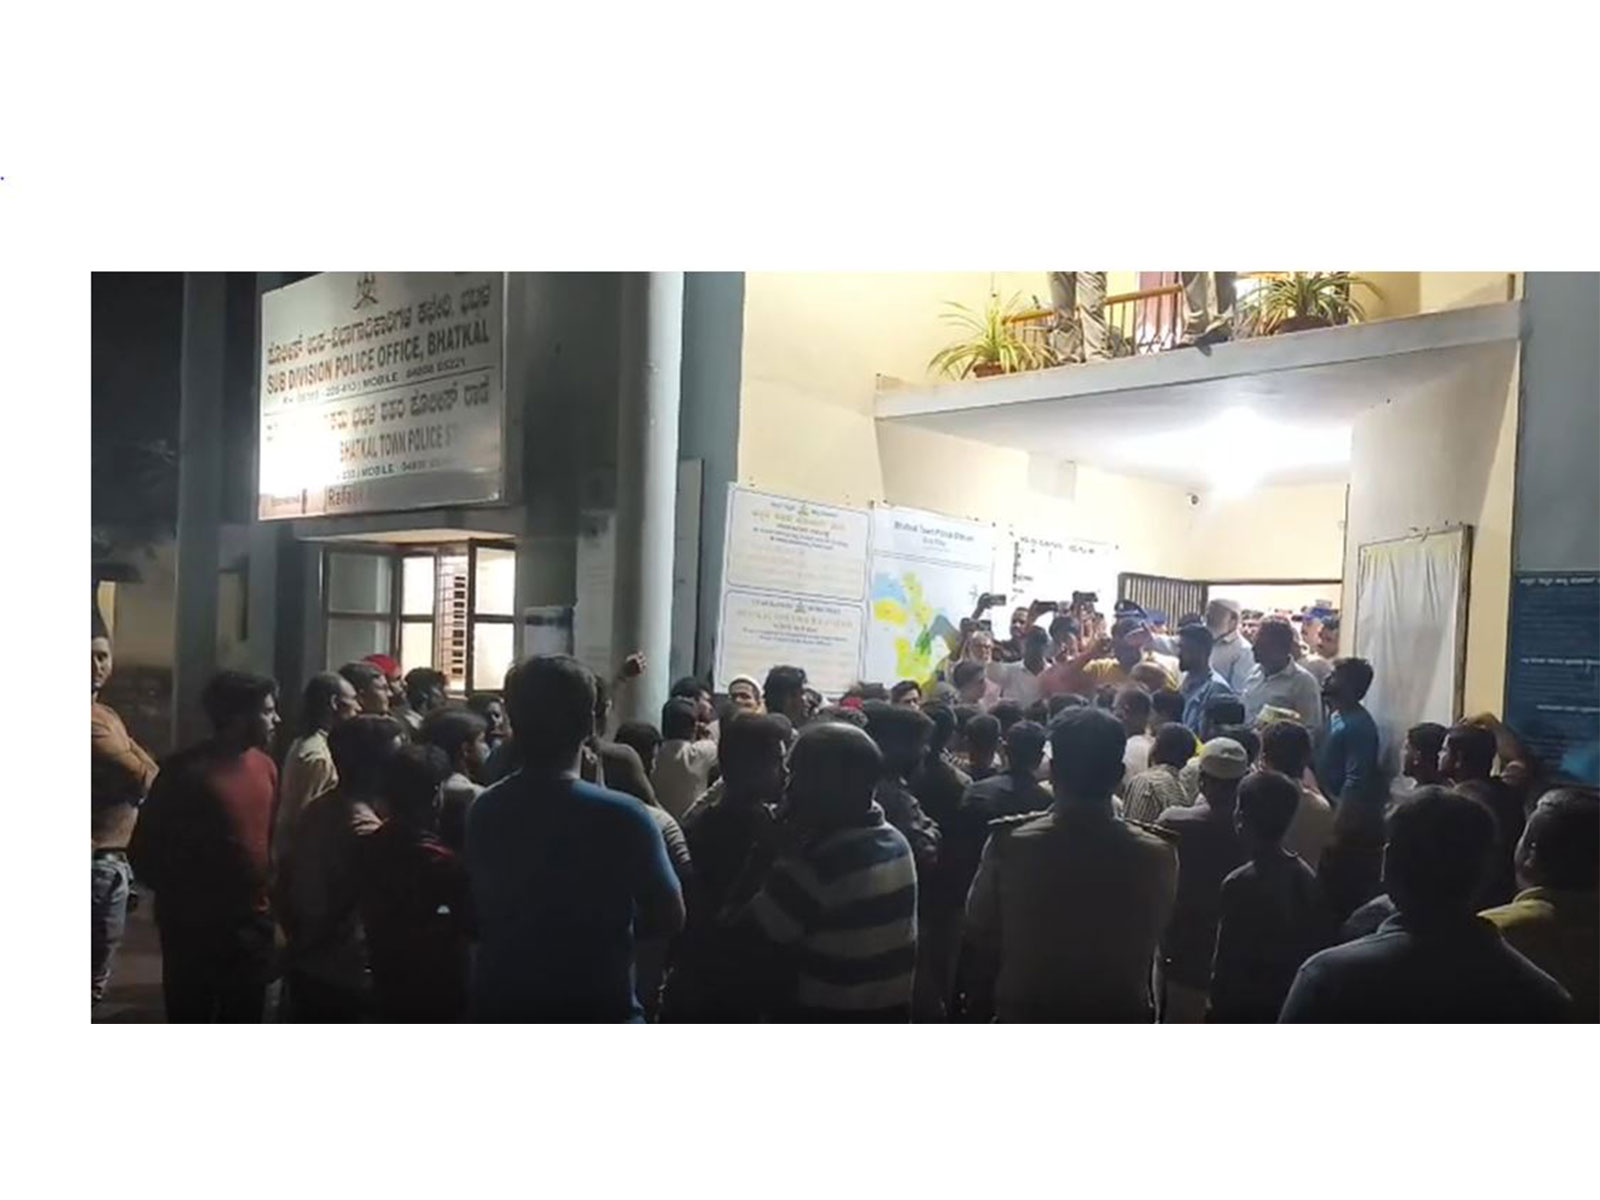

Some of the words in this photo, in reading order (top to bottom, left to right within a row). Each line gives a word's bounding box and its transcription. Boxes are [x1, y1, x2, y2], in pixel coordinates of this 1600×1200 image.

[267, 367, 287, 394] SUB
[288, 359, 332, 390] DIVISION
[336, 347, 375, 378] POLICE
[377, 336, 424, 366] OFFICE,
[427, 319, 491, 357] BHATKAL
[363, 372, 400, 388] MOBILE
[380, 430, 406, 457] TOWN
[408, 424, 444, 452] POLICE
[361, 462, 395, 477] MOBILE
